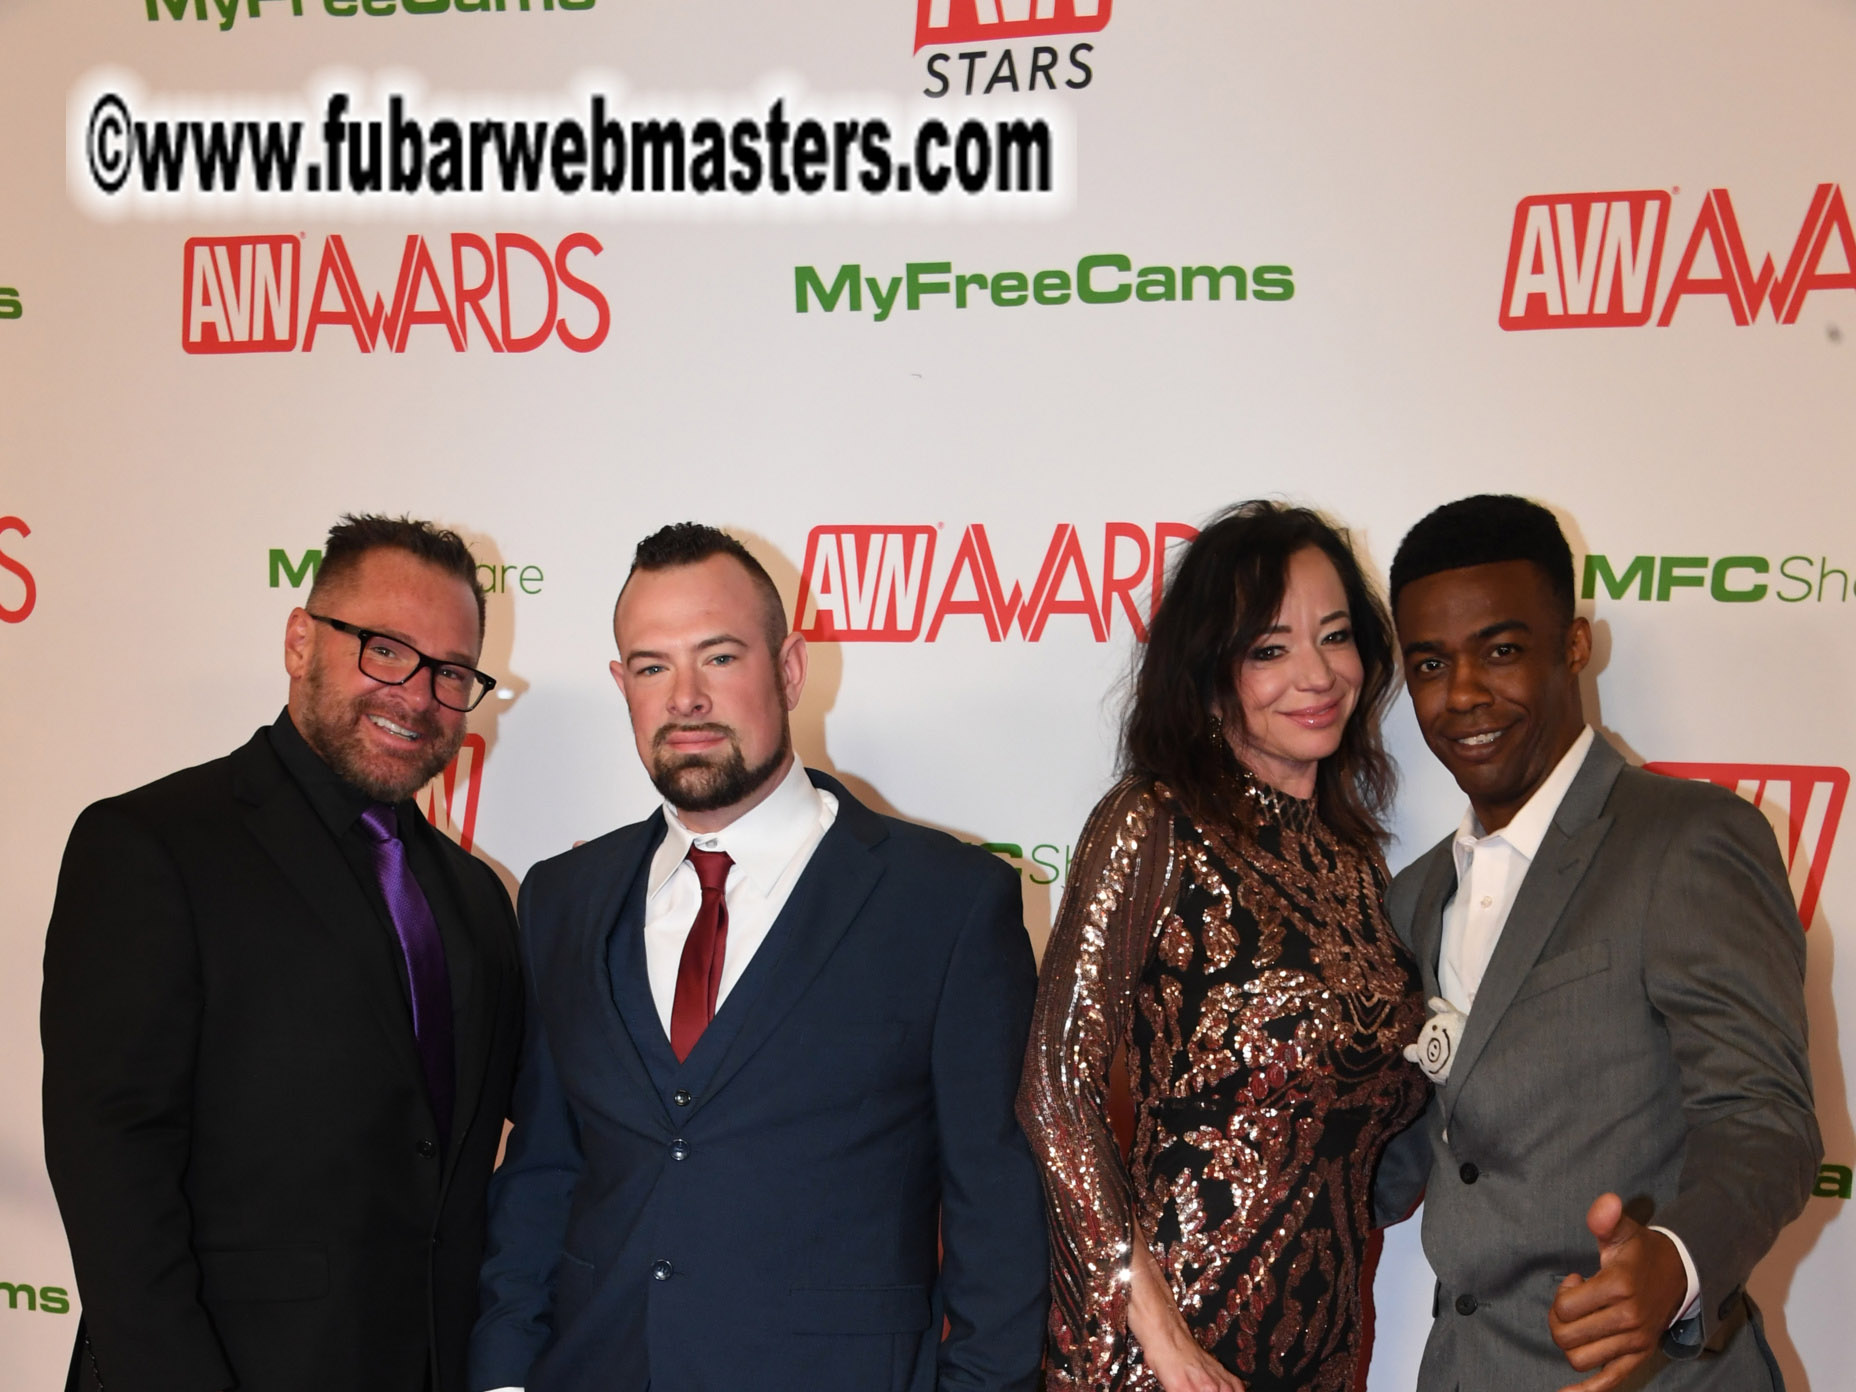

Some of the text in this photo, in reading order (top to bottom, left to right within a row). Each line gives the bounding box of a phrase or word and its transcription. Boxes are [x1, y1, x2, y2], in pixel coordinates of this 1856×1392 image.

[923, 42, 1095, 98] STARS
[188, 232, 611, 353] AVN AWARDS
[795, 253, 1295, 322] MyFreeCams
[1508, 199, 1661, 318] AVN
[800, 532, 929, 631] AVN
[1581, 554, 1856, 603] MFCSh
